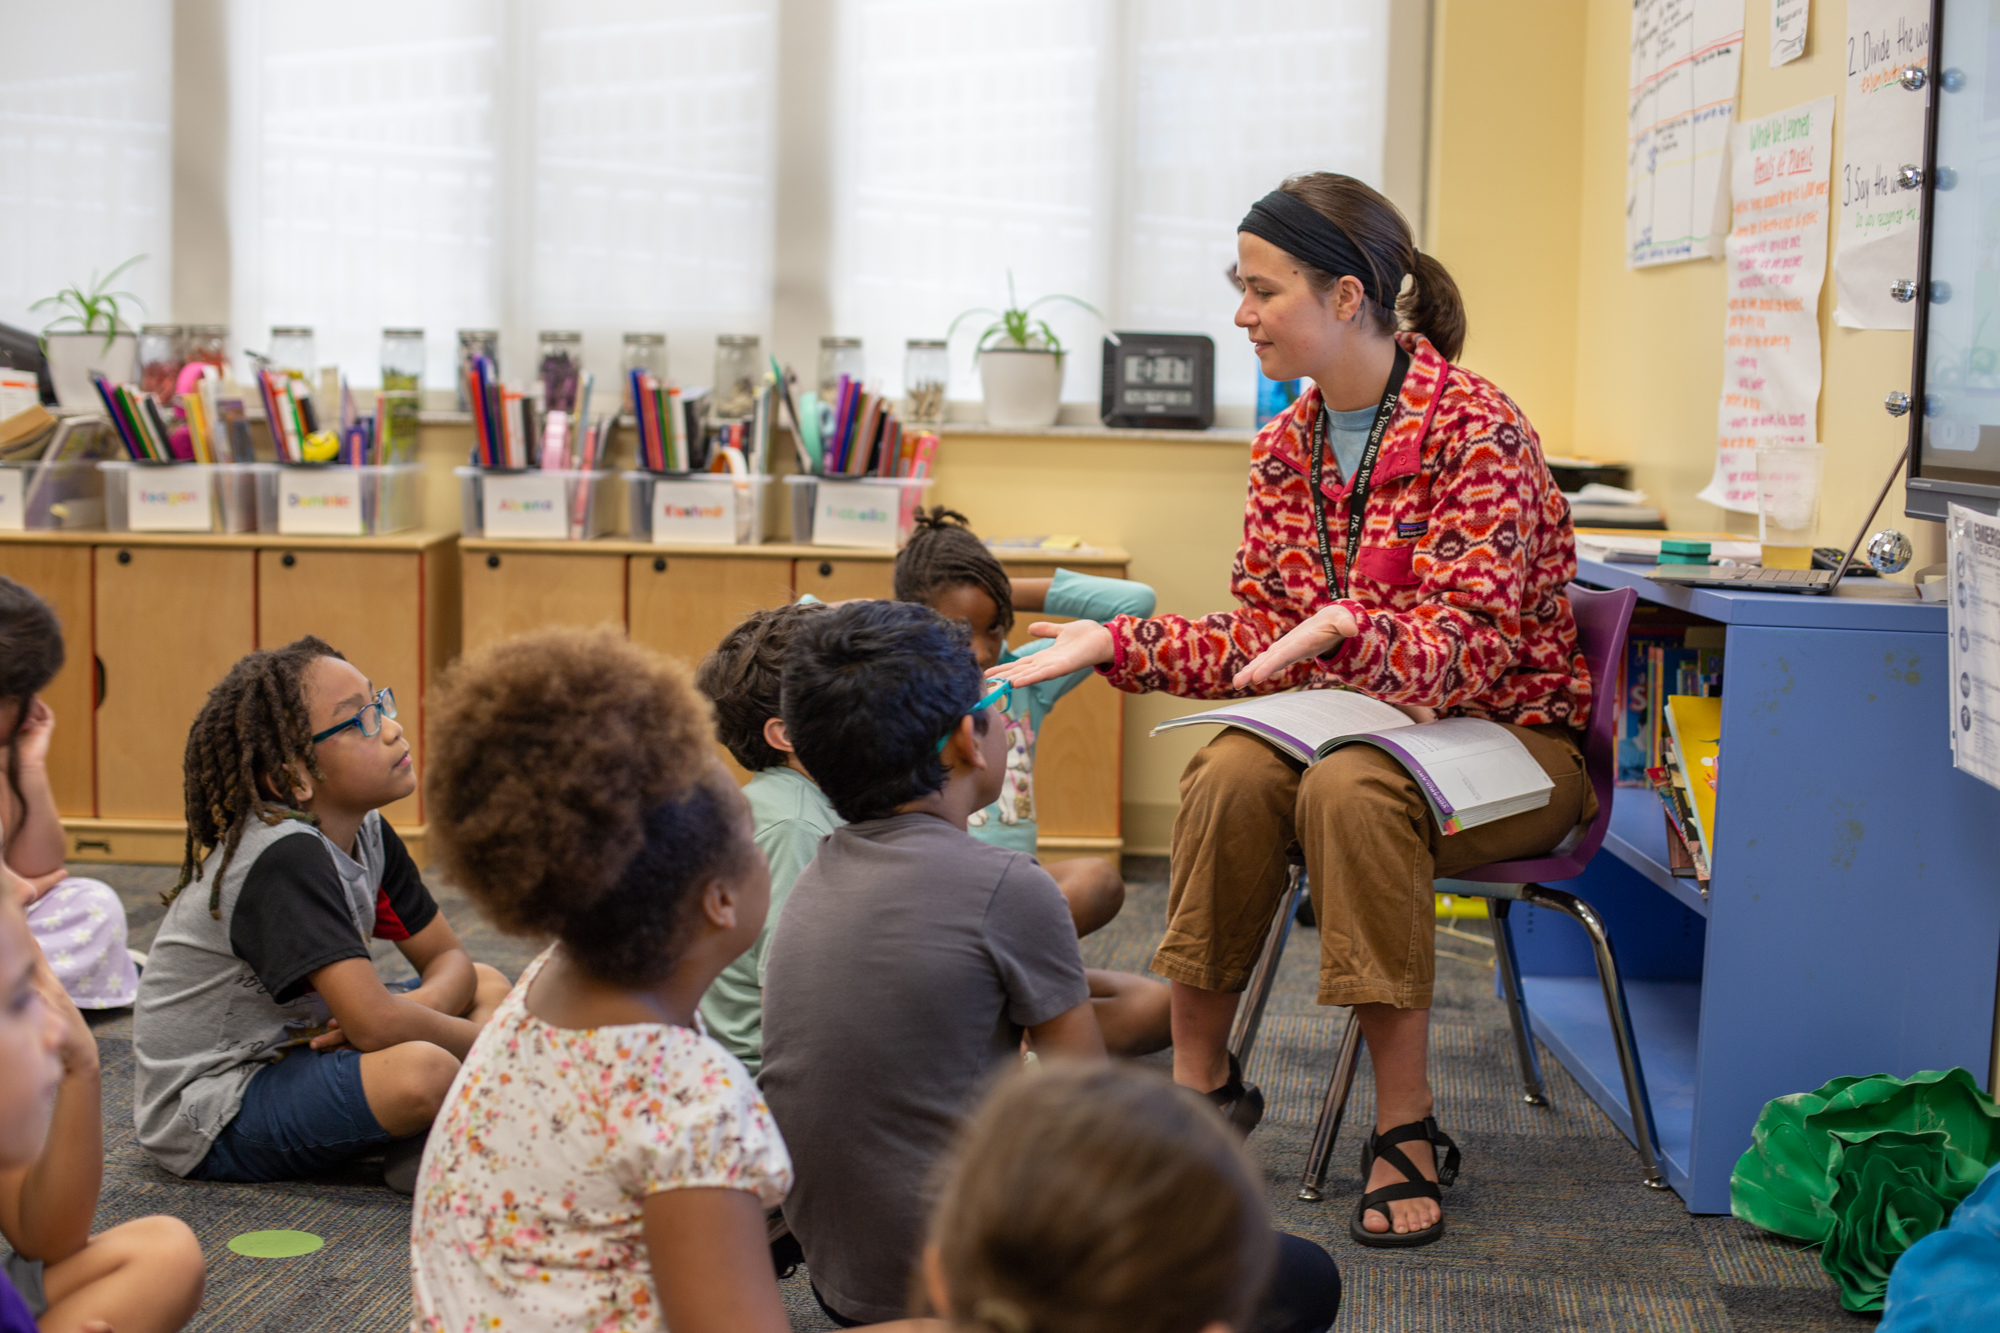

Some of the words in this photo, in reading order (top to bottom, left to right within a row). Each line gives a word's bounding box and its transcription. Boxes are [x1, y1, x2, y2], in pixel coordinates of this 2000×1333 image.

[1848, 36, 1861, 77] 2.
[1863, 29, 1890, 72] Divide
[1897, 15, 1913, 56] the
[1750, 119, 1771, 152] What
[1773, 118, 1783, 143] We
[1874, 163, 1888, 196] the
[1382, 393, 1397, 412] P.K.
[1371, 415, 1390, 443] Yonge
[1312, 433, 1322, 463] Yonge
[1363, 445, 1378, 467] Blue
[1311, 464, 1319, 484] P.K.
[1356, 469, 1371, 495] Wave
[1315, 504, 1323, 531] Wave
[1350, 514, 1360, 533] P.K.
[1319, 532, 1328, 555] Blue
[1323, 556, 1335, 587] Yonge
[1330, 587, 1338, 600] K.
